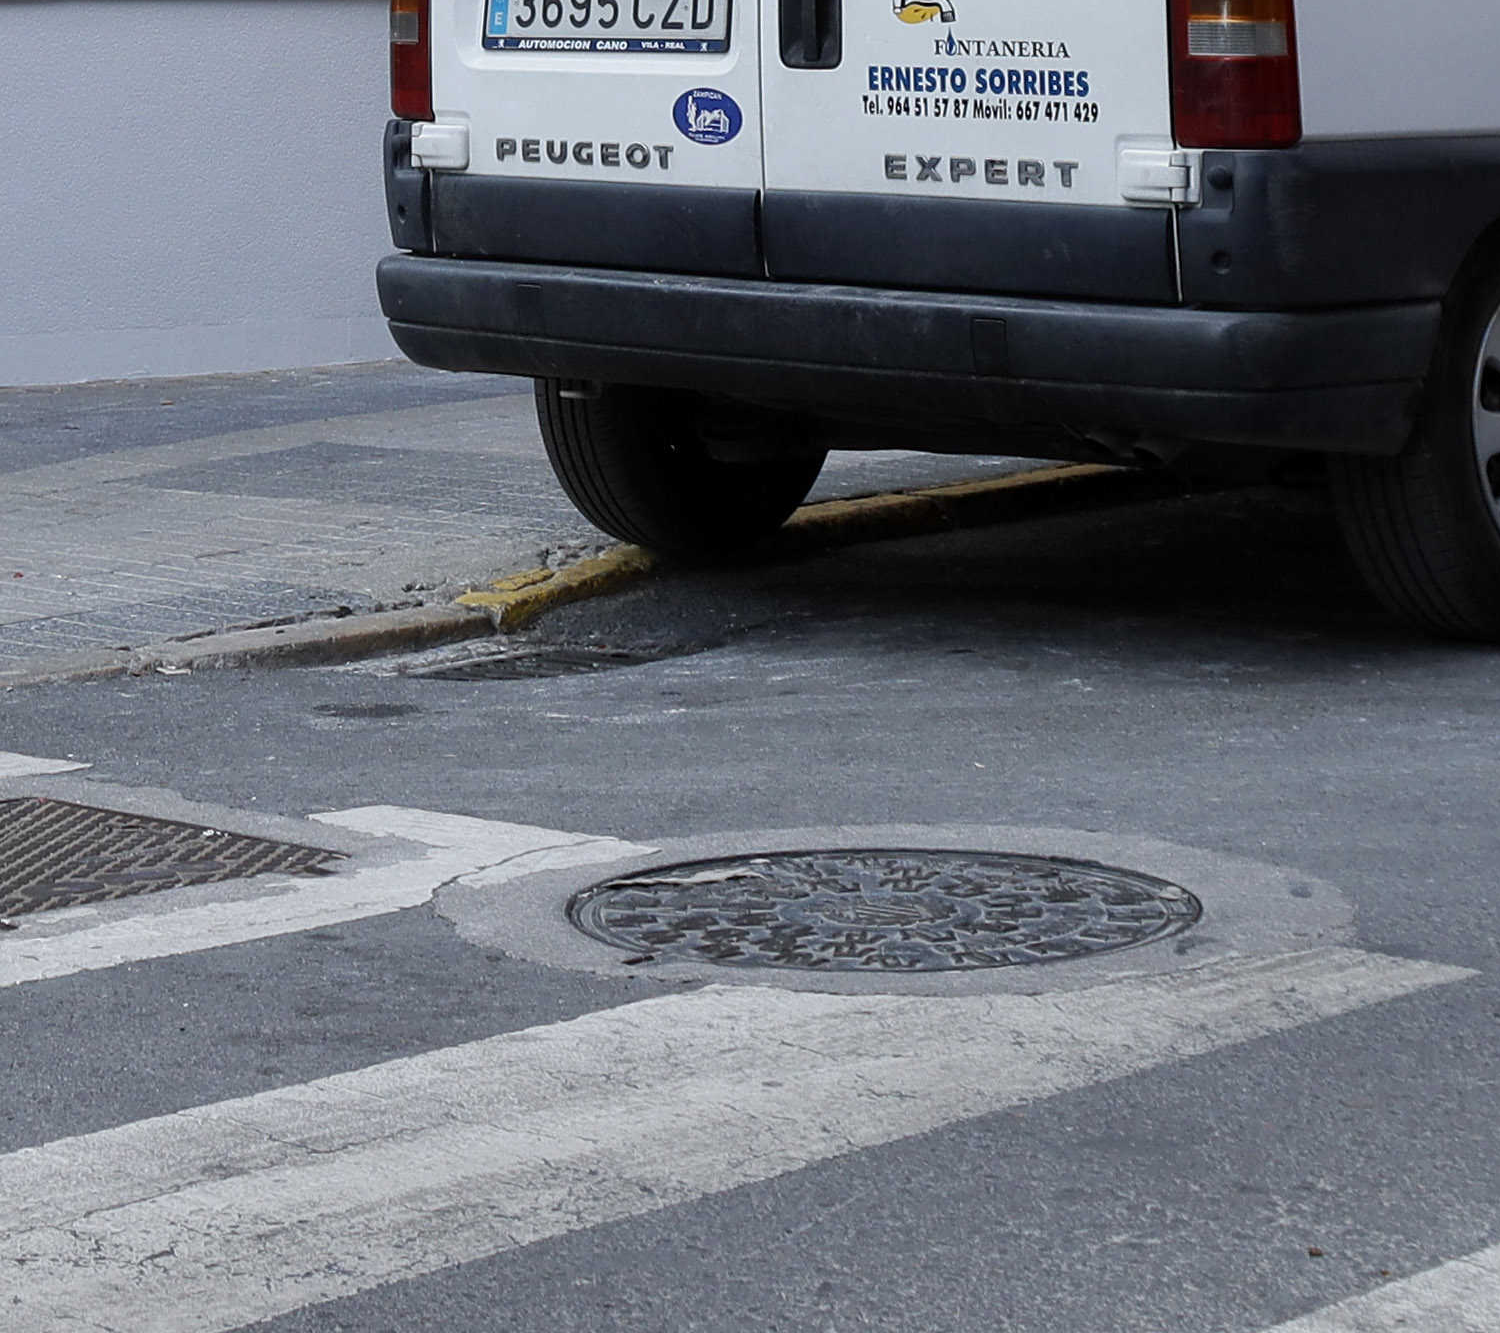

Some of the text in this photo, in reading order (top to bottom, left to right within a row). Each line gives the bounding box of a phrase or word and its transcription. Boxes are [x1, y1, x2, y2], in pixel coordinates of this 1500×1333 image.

[494, 12, 503, 25] E
[518, 39, 591, 51] AUTOMOCION
[596, 40, 629, 51] CANO
[868, 65, 1090, 97] ERNESTO SORRIBES
[863, 95, 1099, 123] Tel. 964 51 57 87 Móvil: 667 471 429
[495, 137, 674, 170] PEUGEOT
[884, 153, 1080, 189] EXPERT
